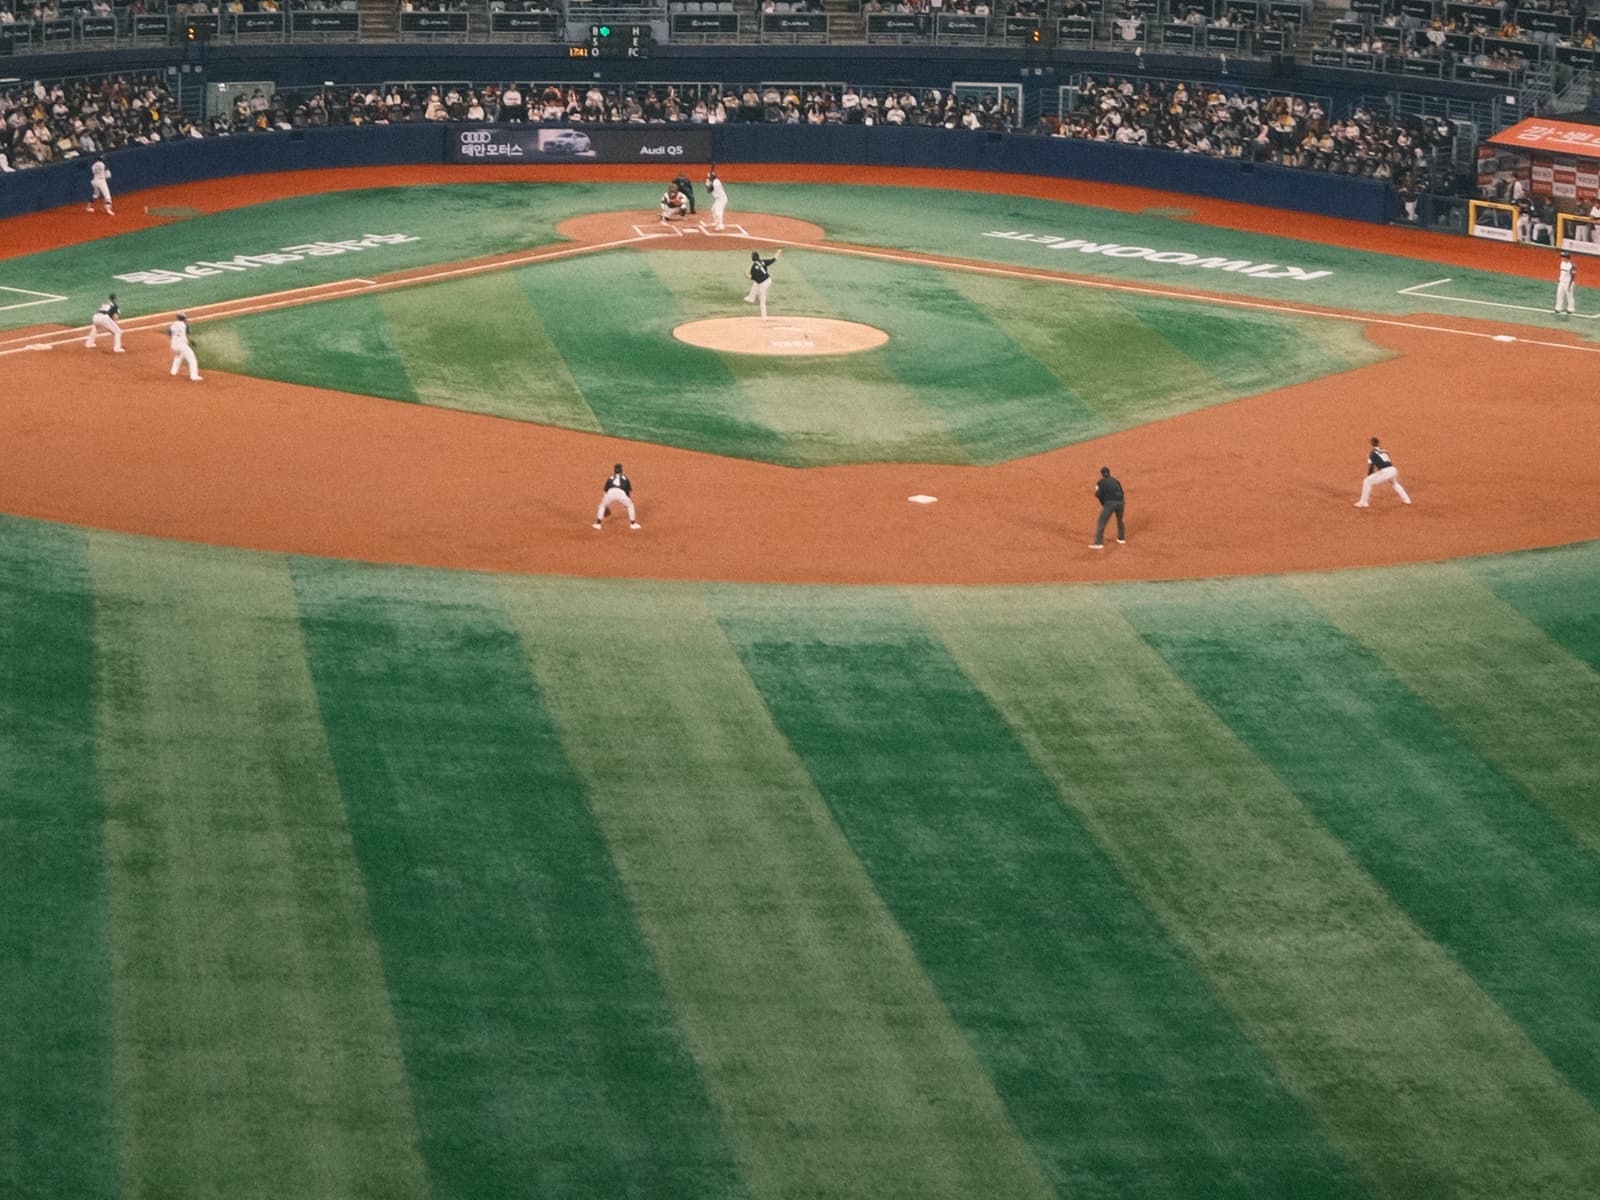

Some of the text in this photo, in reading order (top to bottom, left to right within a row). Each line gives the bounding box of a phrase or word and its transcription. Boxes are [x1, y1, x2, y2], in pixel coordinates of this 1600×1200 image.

[592, 26, 599, 36] B
[632, 26, 640, 36] H
[592, 37, 599, 46] S
[632, 37, 639, 46] E
[640, 145, 683, 156] Audi Q5
[980, 231, 1334, 281] KIWOOM ETF
